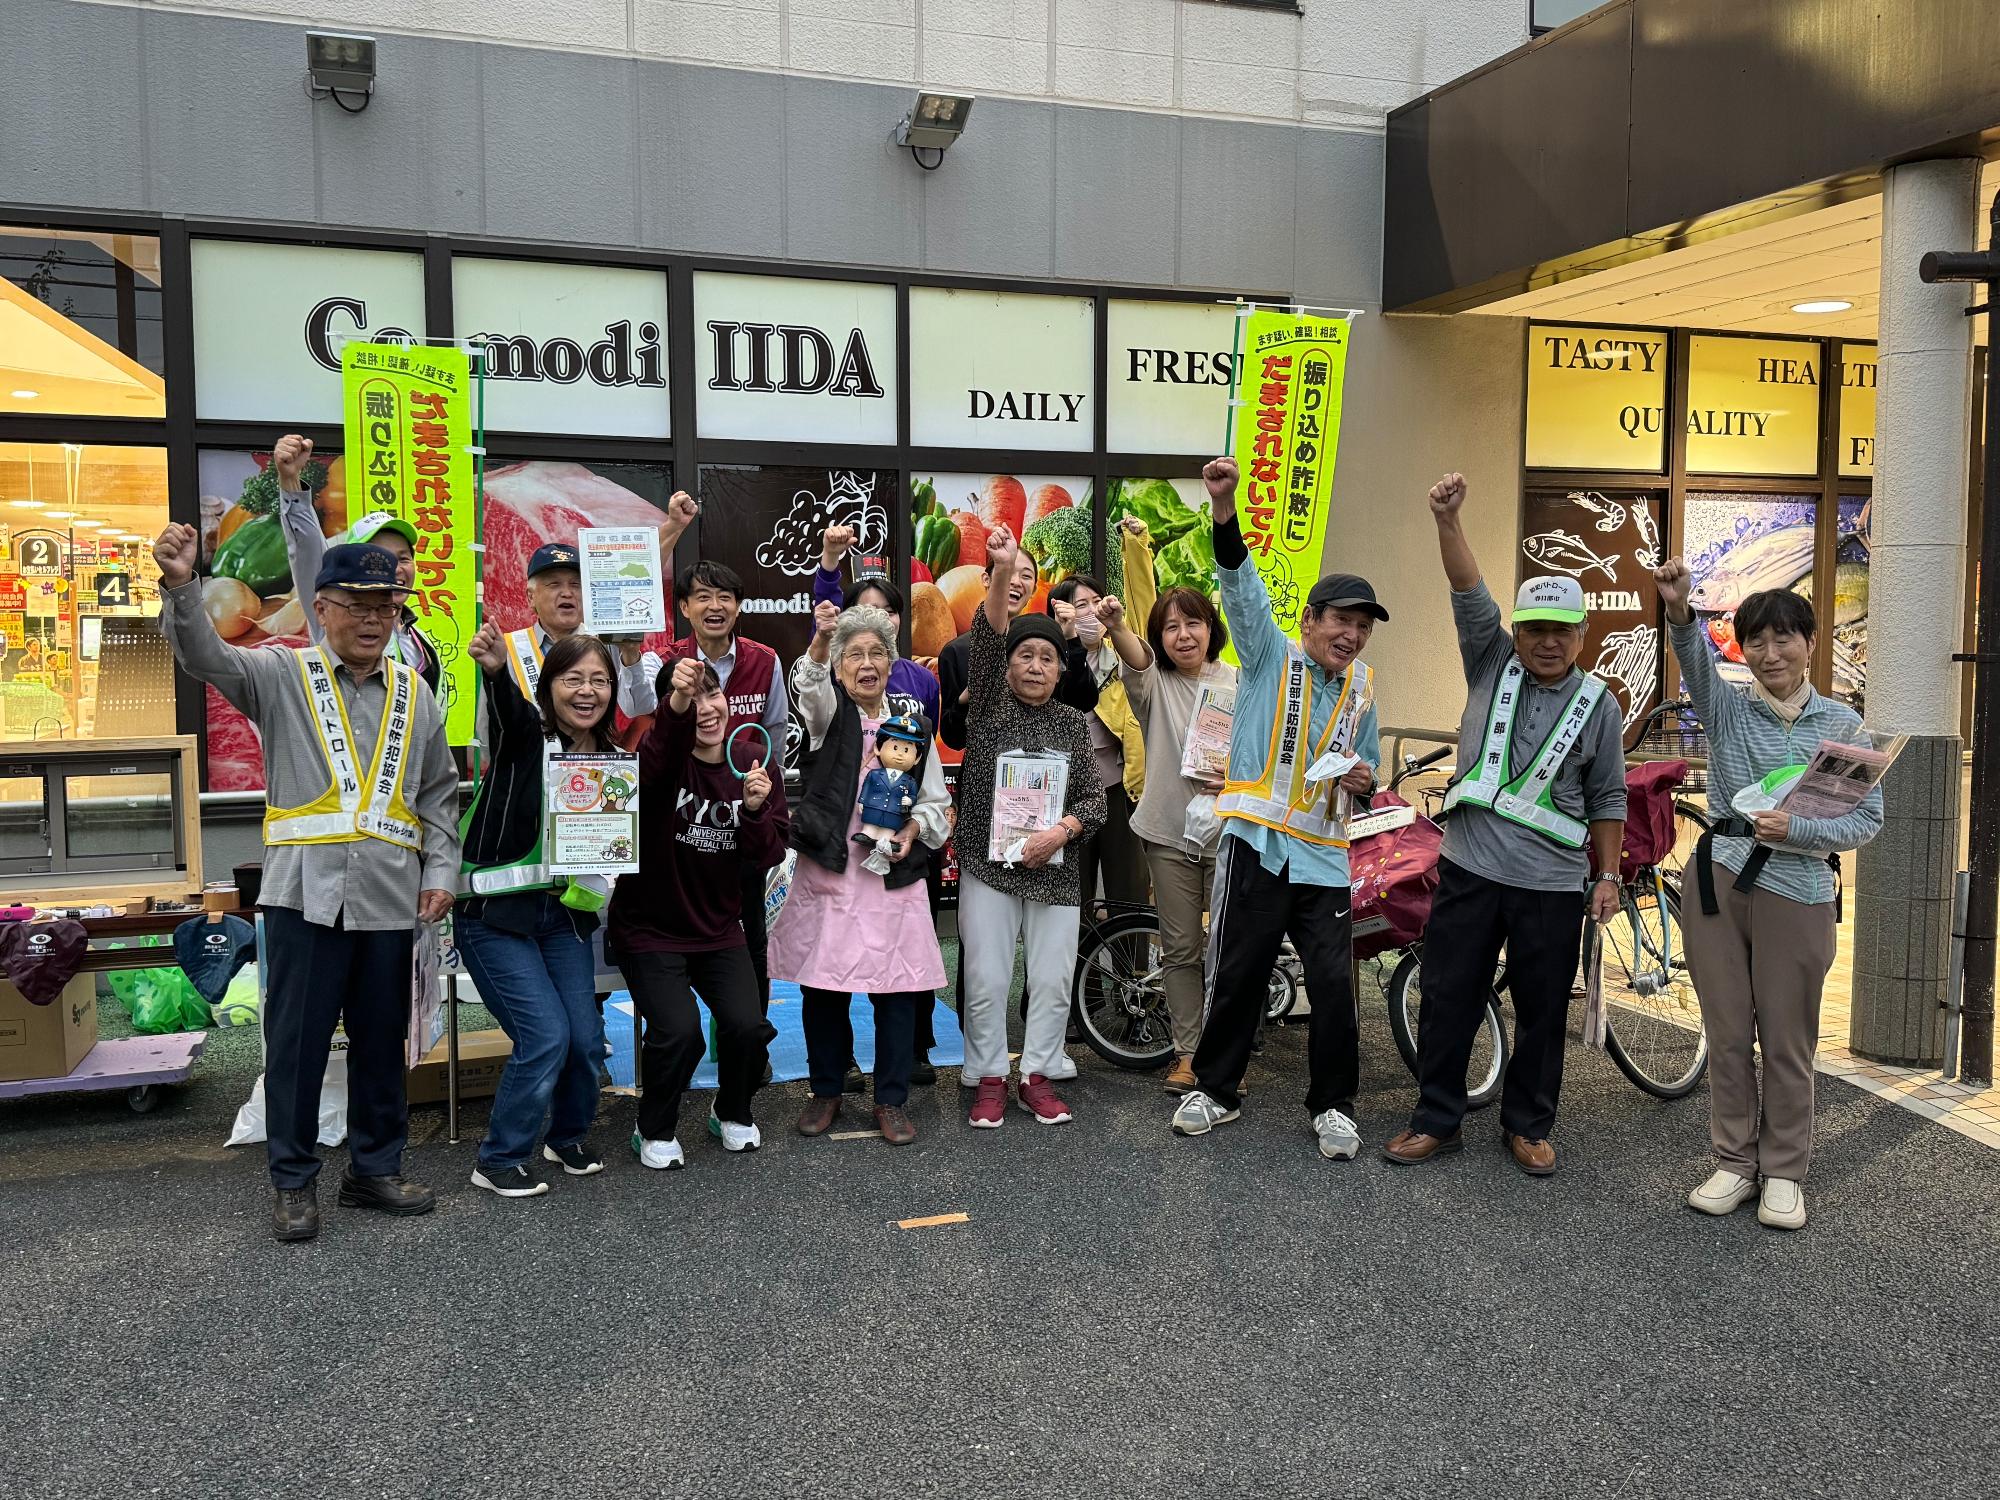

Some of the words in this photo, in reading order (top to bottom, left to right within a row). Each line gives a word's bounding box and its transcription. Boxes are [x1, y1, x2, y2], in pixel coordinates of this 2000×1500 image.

[707, 320, 884, 398] IIDA
[1545, 337, 1662, 372] TASTY
[967, 389, 1086, 422] DAILY
[1619, 405, 1772, 438] QUALITY
[1285, 359, 1329, 541] 振り込め詐欺に
[32, 540, 48, 564] 2
[101, 577, 125, 602] 4
[307, 660, 356, 793] 防犯パトロール
[730, 702, 765, 717] POLIC
[1279, 659, 1304, 766] 春日部市防犯協会
[1487, 665, 1521, 765] 春日部市
[377, 670, 409, 796] 春日部市防犯協会
[1534, 695, 1592, 781] 防犯パトロール
[675, 833, 721, 850] BASKETBALL
[688, 826, 734, 841] UNIVERSITY
